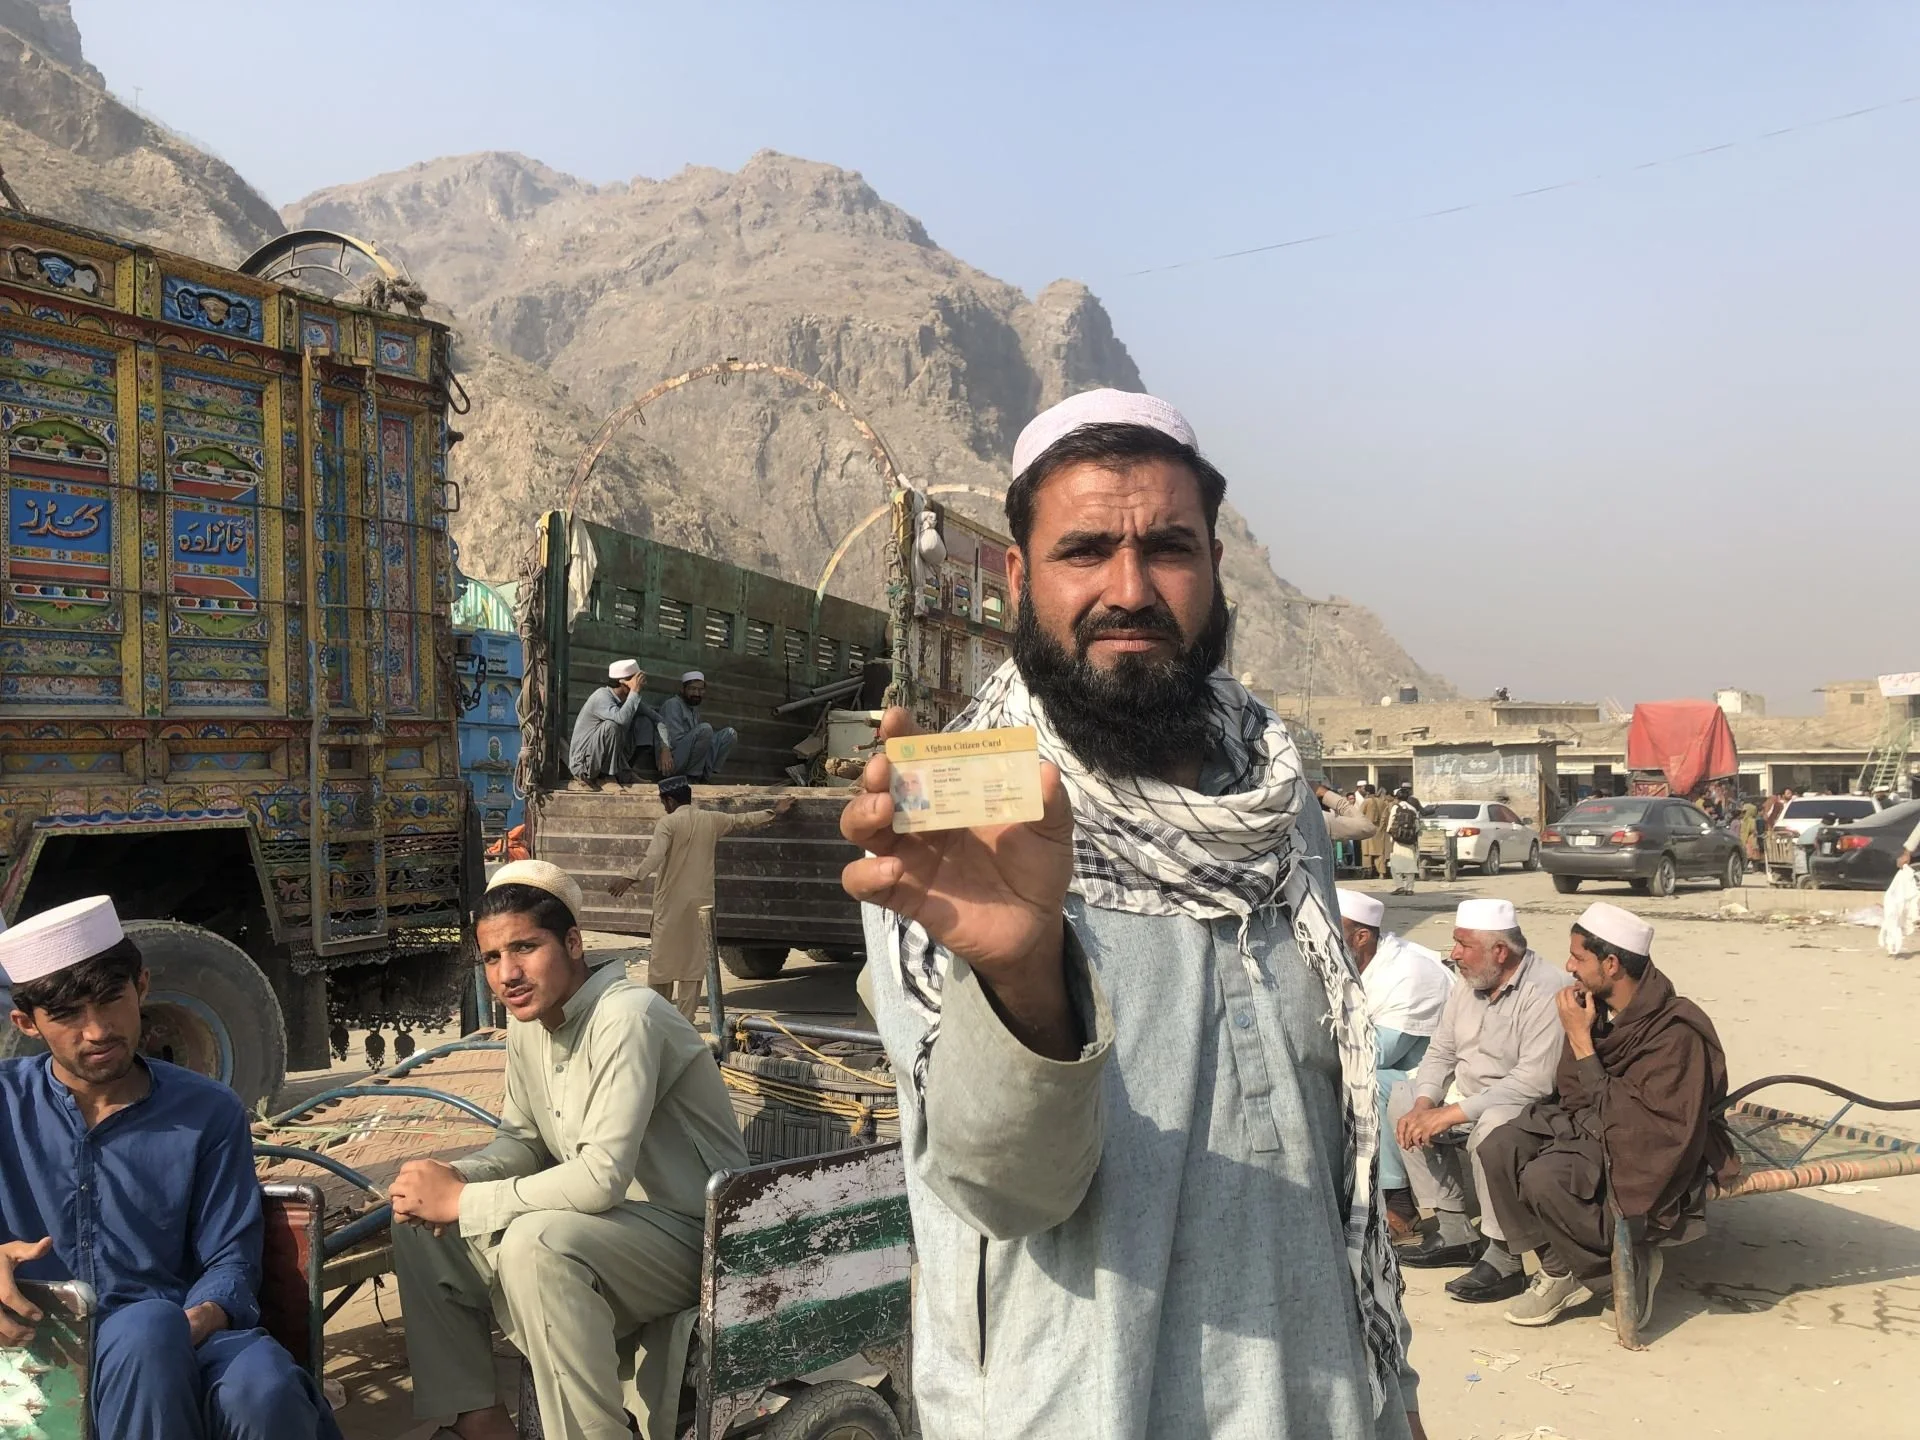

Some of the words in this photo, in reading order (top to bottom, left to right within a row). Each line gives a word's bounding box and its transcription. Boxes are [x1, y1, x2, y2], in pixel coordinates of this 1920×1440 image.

[925, 744, 952, 753] Afghan
[953, 741, 980, 750] Citizen
[982, 738, 1002, 748] Card
